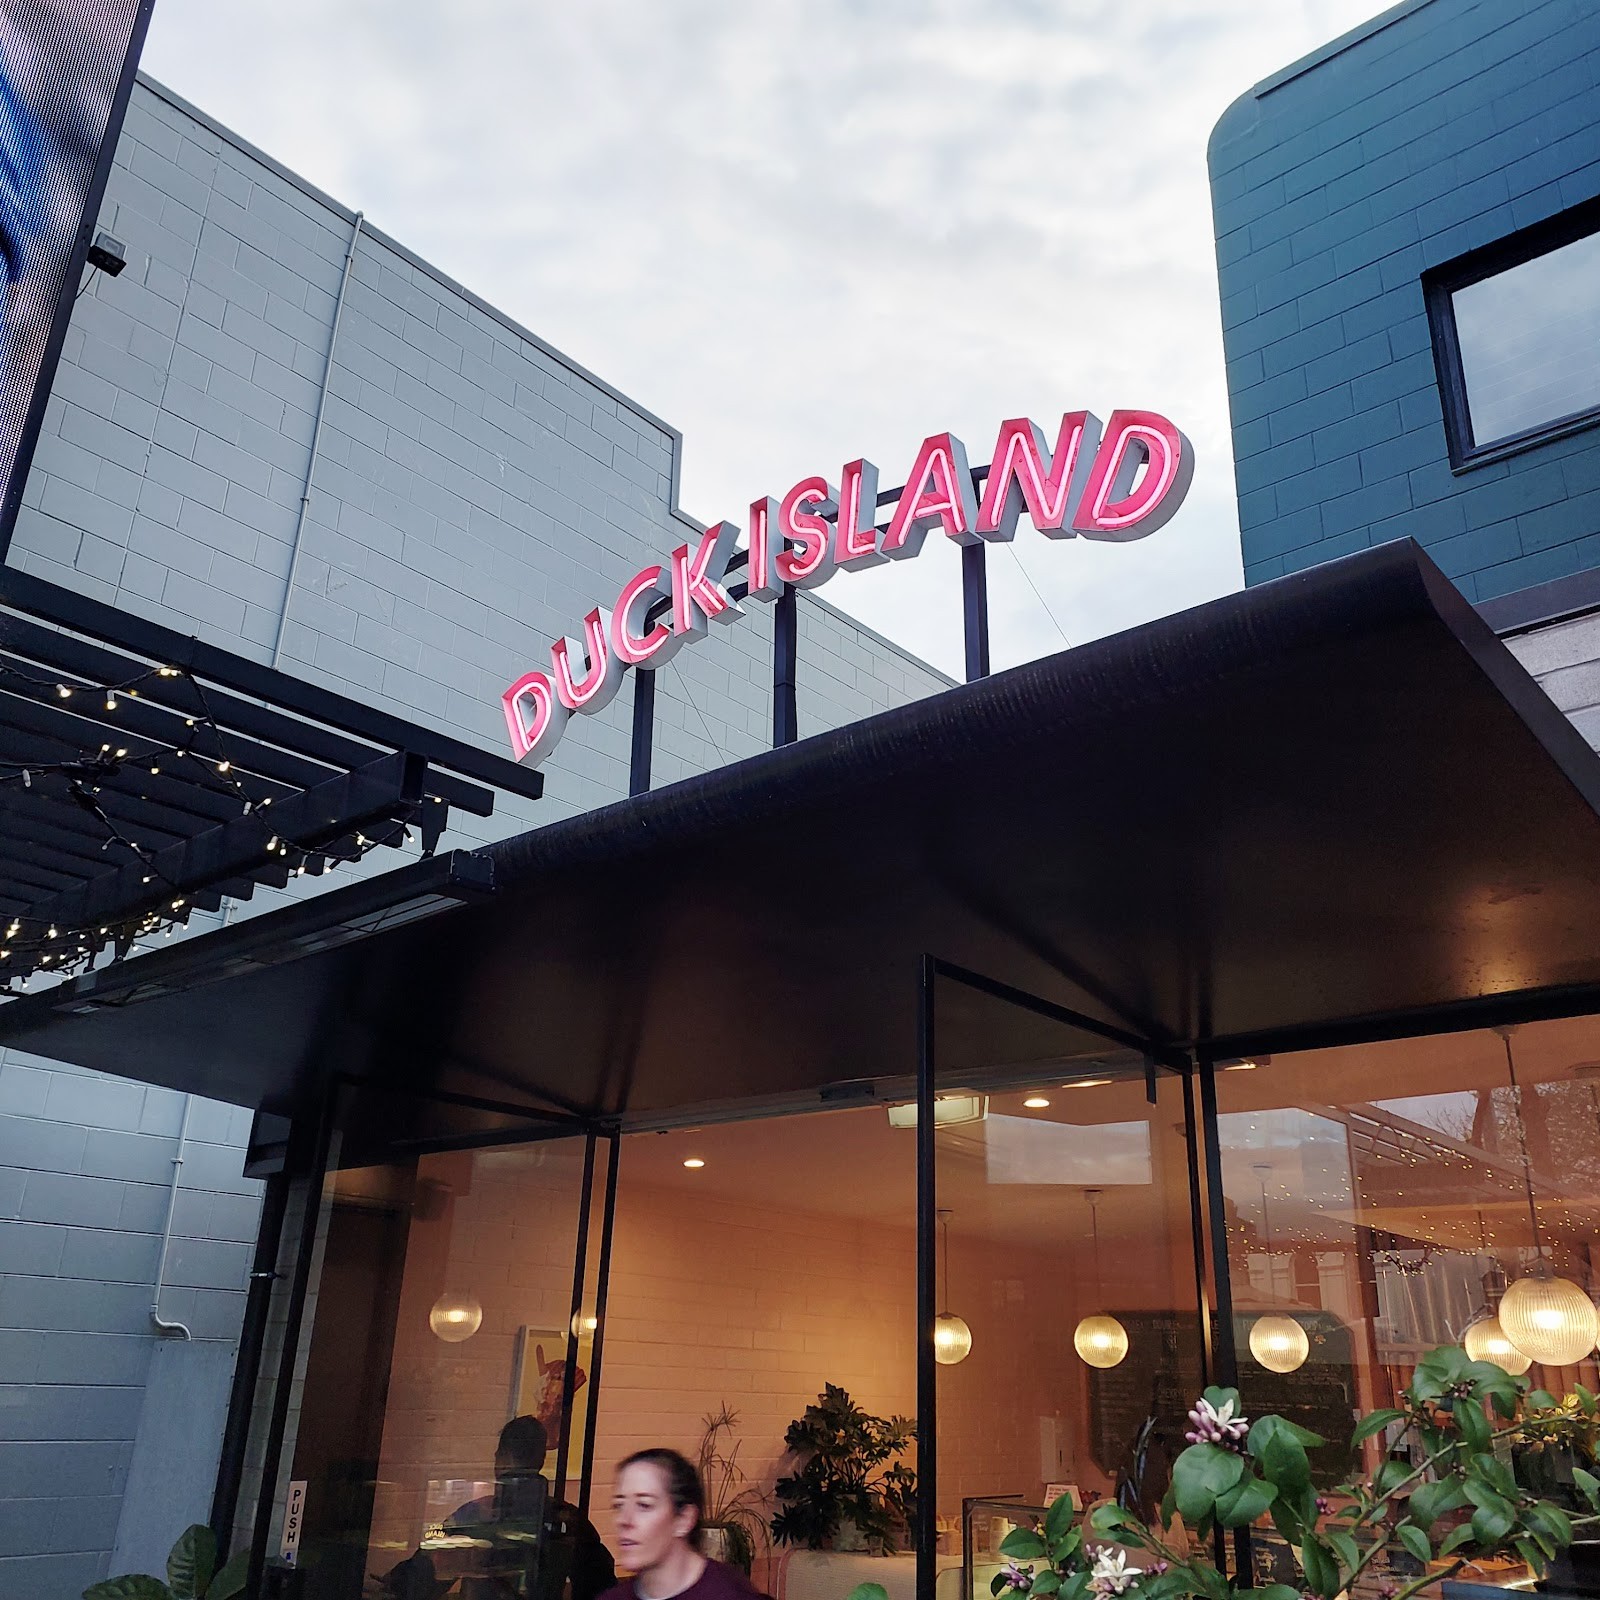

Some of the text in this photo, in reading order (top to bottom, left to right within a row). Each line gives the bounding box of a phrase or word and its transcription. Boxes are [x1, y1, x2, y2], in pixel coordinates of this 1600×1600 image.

[502, 410, 1194, 768] DUCK ISLAND
[287, 1489, 301, 1543] PUSH
